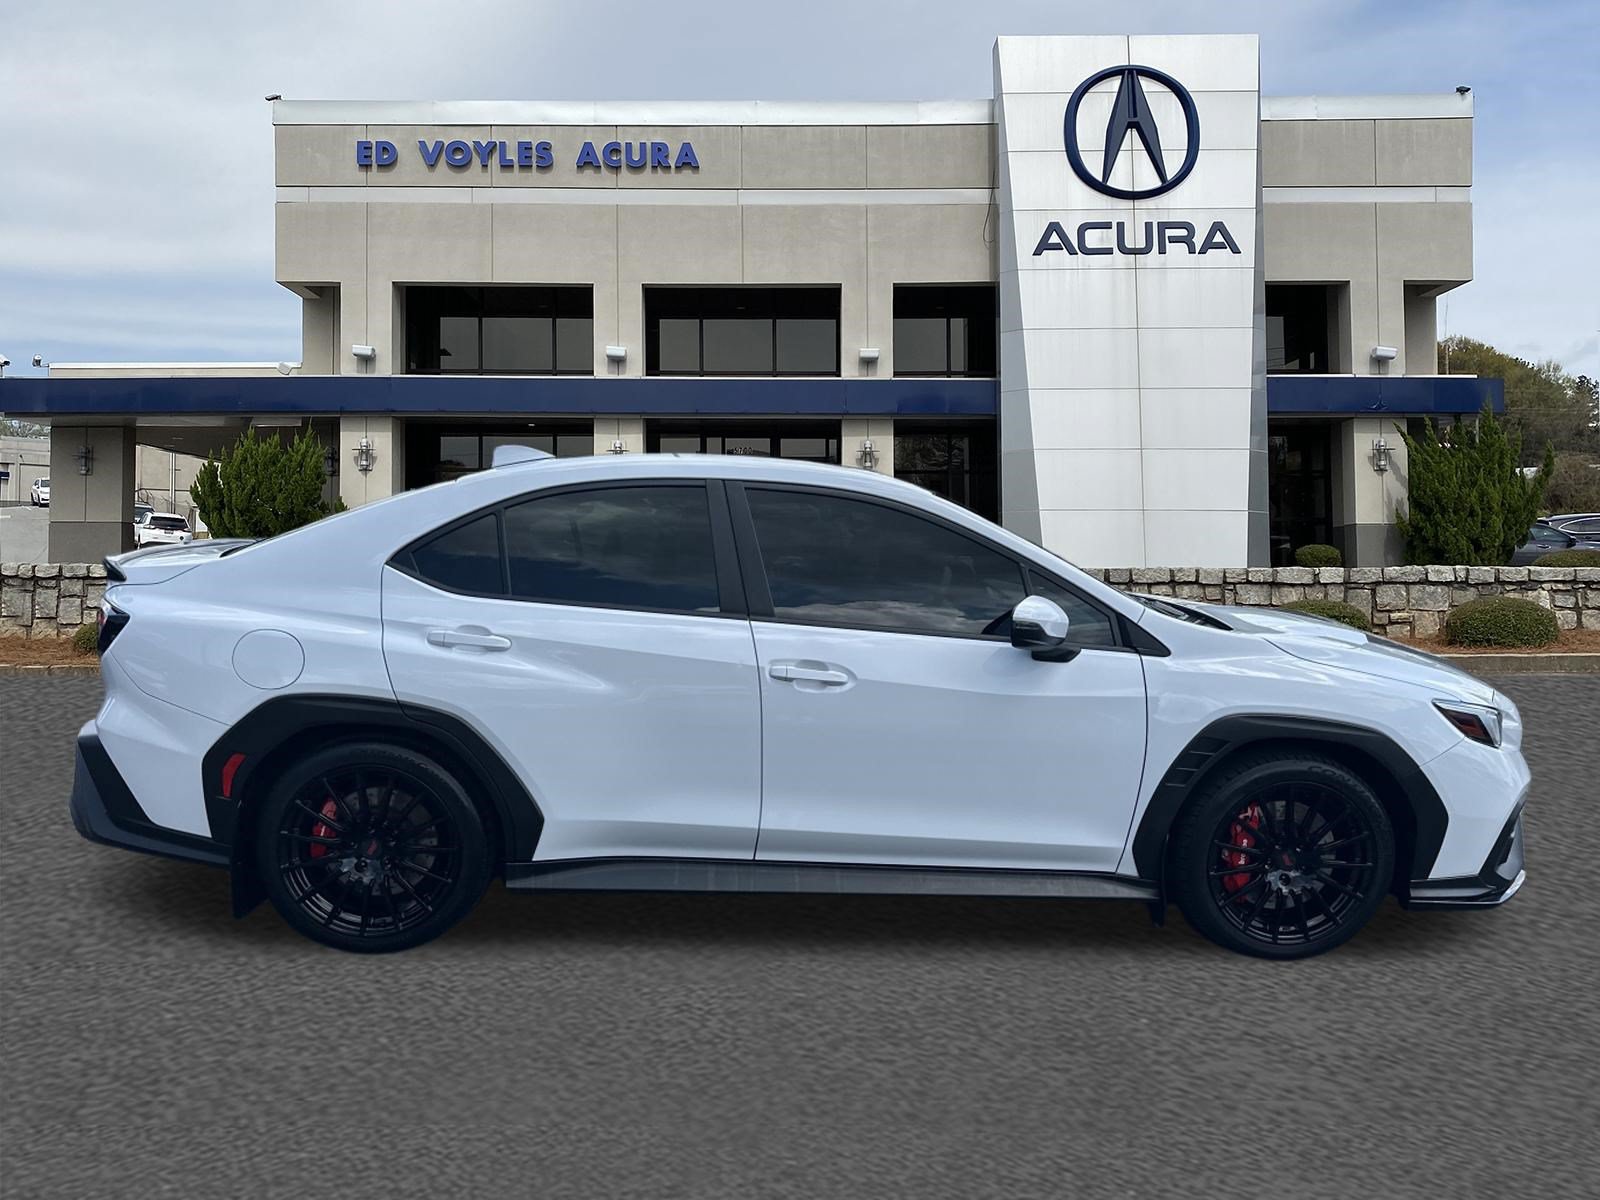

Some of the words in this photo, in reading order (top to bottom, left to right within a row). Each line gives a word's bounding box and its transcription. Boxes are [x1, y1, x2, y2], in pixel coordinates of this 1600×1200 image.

[356, 140, 398, 167] ED
[418, 140, 554, 168] VOYLES
[576, 141, 700, 168] ACURA
[1032, 221, 1242, 256] ACURA
